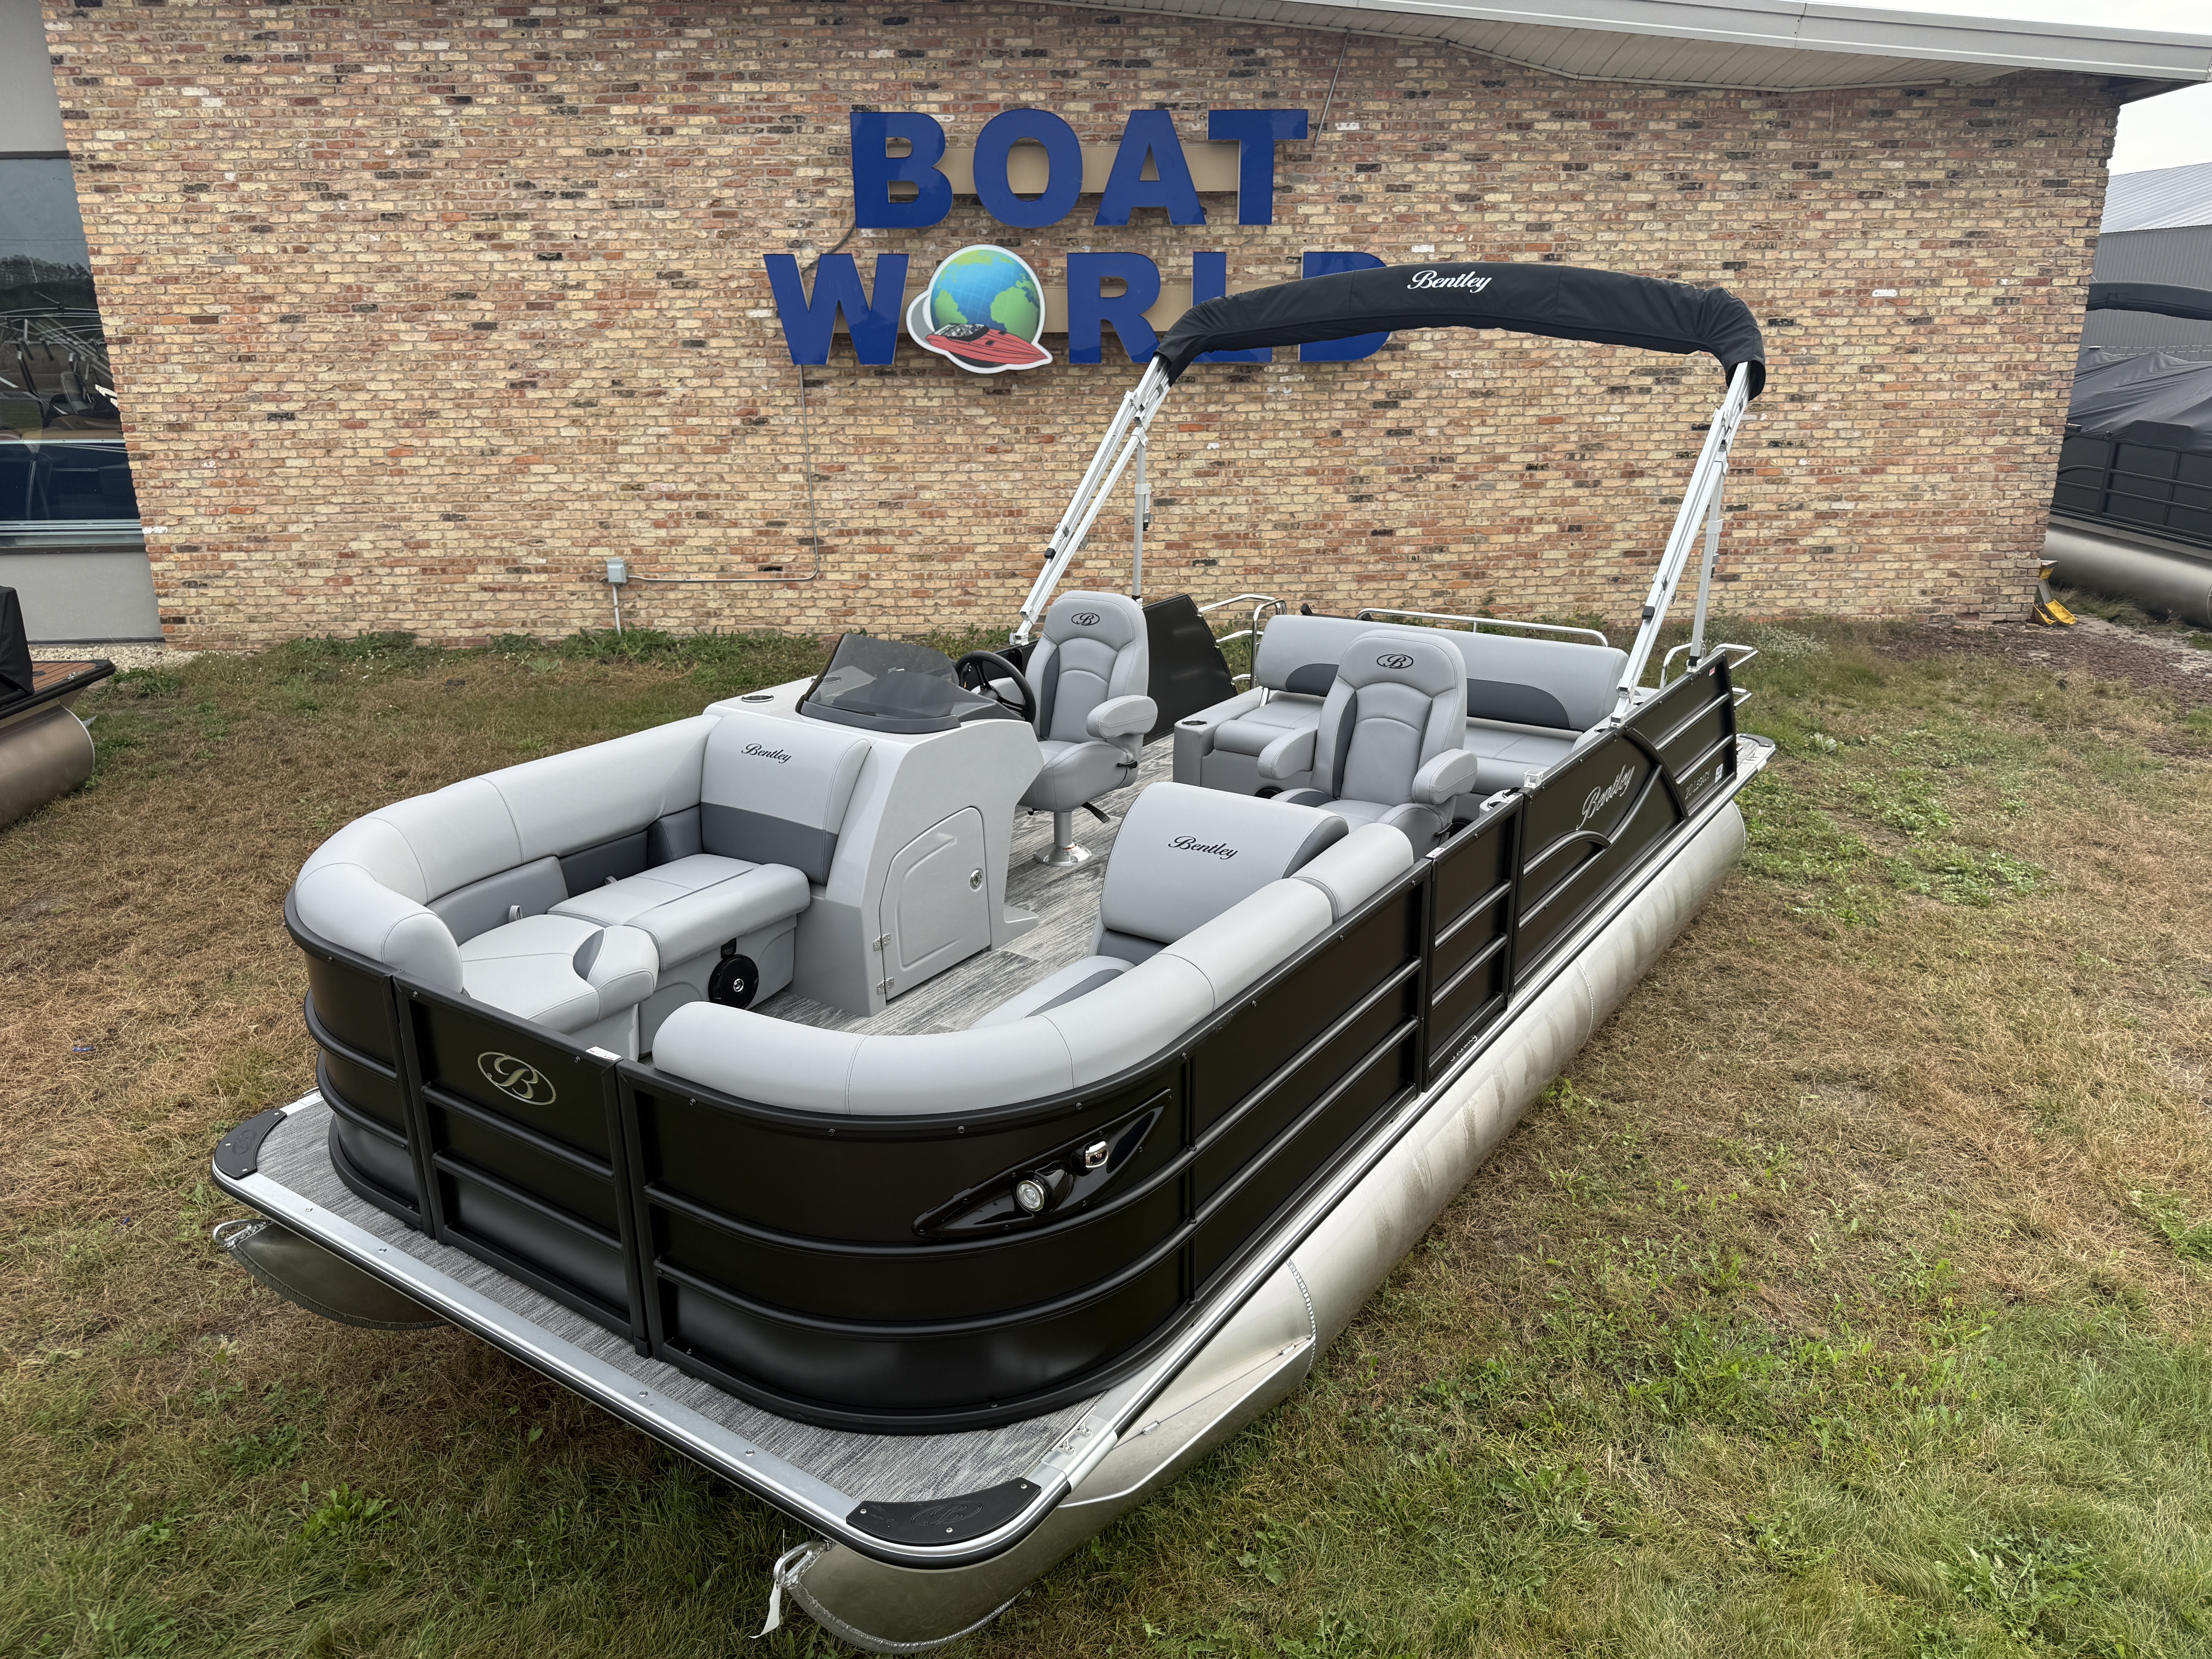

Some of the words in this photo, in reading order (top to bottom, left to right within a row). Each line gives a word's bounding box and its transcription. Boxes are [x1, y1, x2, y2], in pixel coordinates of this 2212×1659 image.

[850, 108, 1308, 228] BOAT
[1407, 270, 1492, 293] Bentley
[741, 743, 792, 764] Bentley
[1575, 764, 1636, 831] Bentley
[1168, 836, 1238, 860] Bentley
